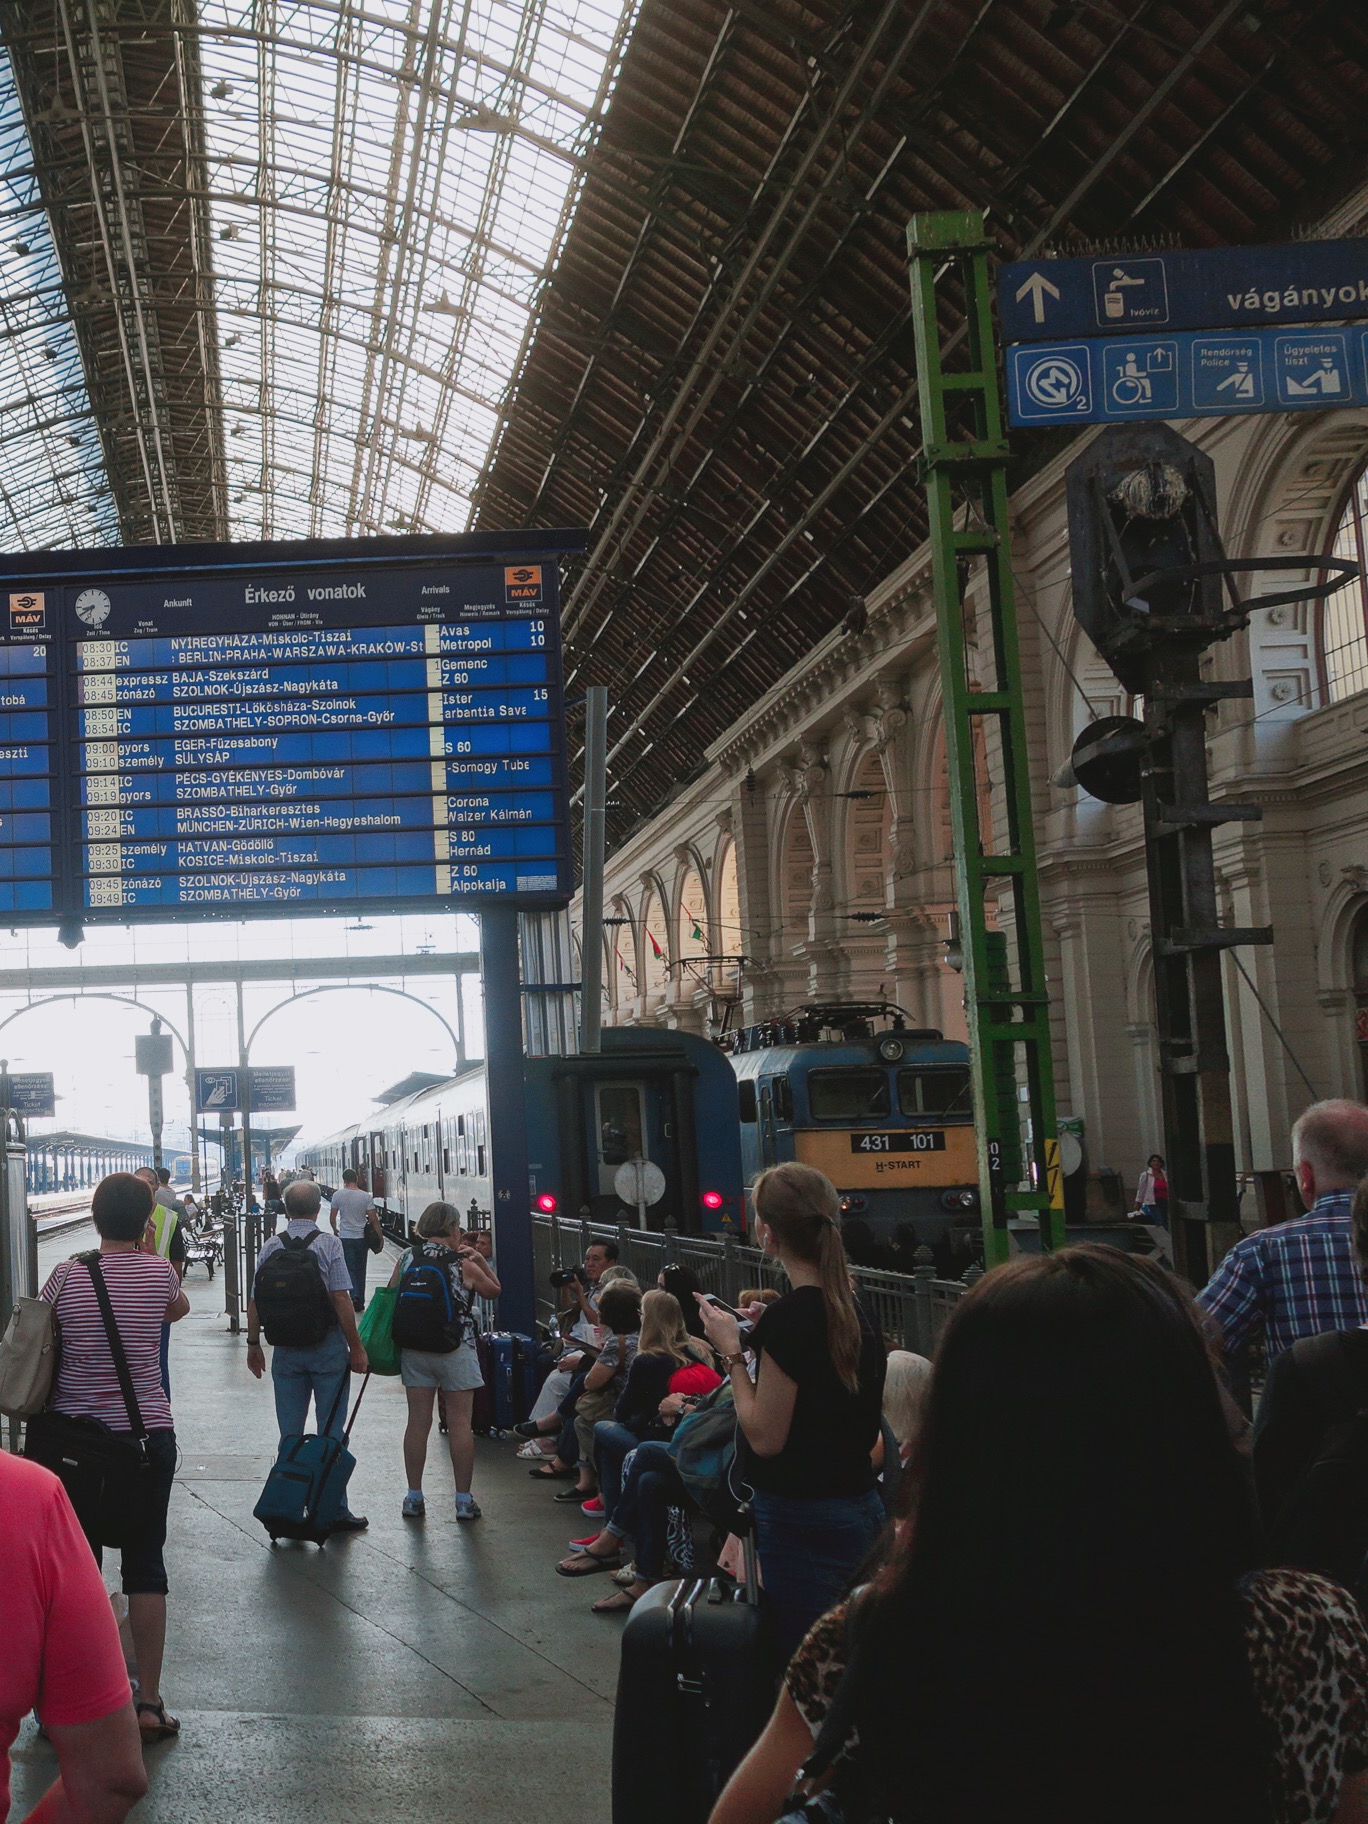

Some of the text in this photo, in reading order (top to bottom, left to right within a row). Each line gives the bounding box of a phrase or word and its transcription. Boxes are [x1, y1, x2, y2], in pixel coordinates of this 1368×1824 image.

[1076, 397, 1087, 409] 2
[164, 583, 450, 607] Ankunft Érkező vonatok Arrivals
[511, 588, 537, 597] MÁV
[15, 613, 41, 623] MÁV
[83, 621, 544, 653] 08:30 IC NYÍREGYHÁZA-Miskolc-Tiszai Avas 10
[33, 647, 46, 657] 20
[83, 657, 112, 667] 08:37
[116, 656, 130, 666] EN
[441, 638, 491, 651] Metropol
[531, 636, 545, 646] 10
[84, 659, 487, 687] 08:44 expressz BAJA-Szekszárd Gemenc
[84, 673, 468, 700] 08:45 zónázó SZOLNOK-Újszász-Nagykáta 60
[85, 710, 113, 720] 08:50
[118, 709, 131, 719] EN
[444, 694, 472, 704] Ister
[534, 689, 548, 700] 15
[85, 724, 114, 734] 08:54
[118, 723, 130, 733] IC
[86, 737, 278, 755] 09:00 gyors EGER-Füzesabony
[86, 758, 115, 768] 09:10
[119, 756, 164, 768] személy
[457, 741, 471, 752] 60
[87, 767, 345, 787] 09:14 IC PÉCS-GYÉKÉNYES-Dombóvár
[87, 785, 297, 803] 09:19 gyors SZOMBATHELY-Győr
[88, 797, 489, 821] 09:20 IC BRASSÓ-Biharkeresztes Corona
[88, 825, 117, 836] 09:24
[121, 825, 135, 834] EN
[89, 831, 475, 856] 09:25 személy HATVAN-Gödöllő 80
[89, 844, 491, 870] 09:30 IC KOSICE-Miskolc-Tiszai Hernád
[90, 866, 477, 890] 09:45 zónázó SZOLNOK-Újszász-Nagykáta 60
[90, 894, 119, 904] 09:49
[122, 893, 136, 903] IC
[452, 879, 506, 893] Alpokalja
[860, 1134, 933, 1150] 431 101
[876, 1160, 921, 1171] H-START
